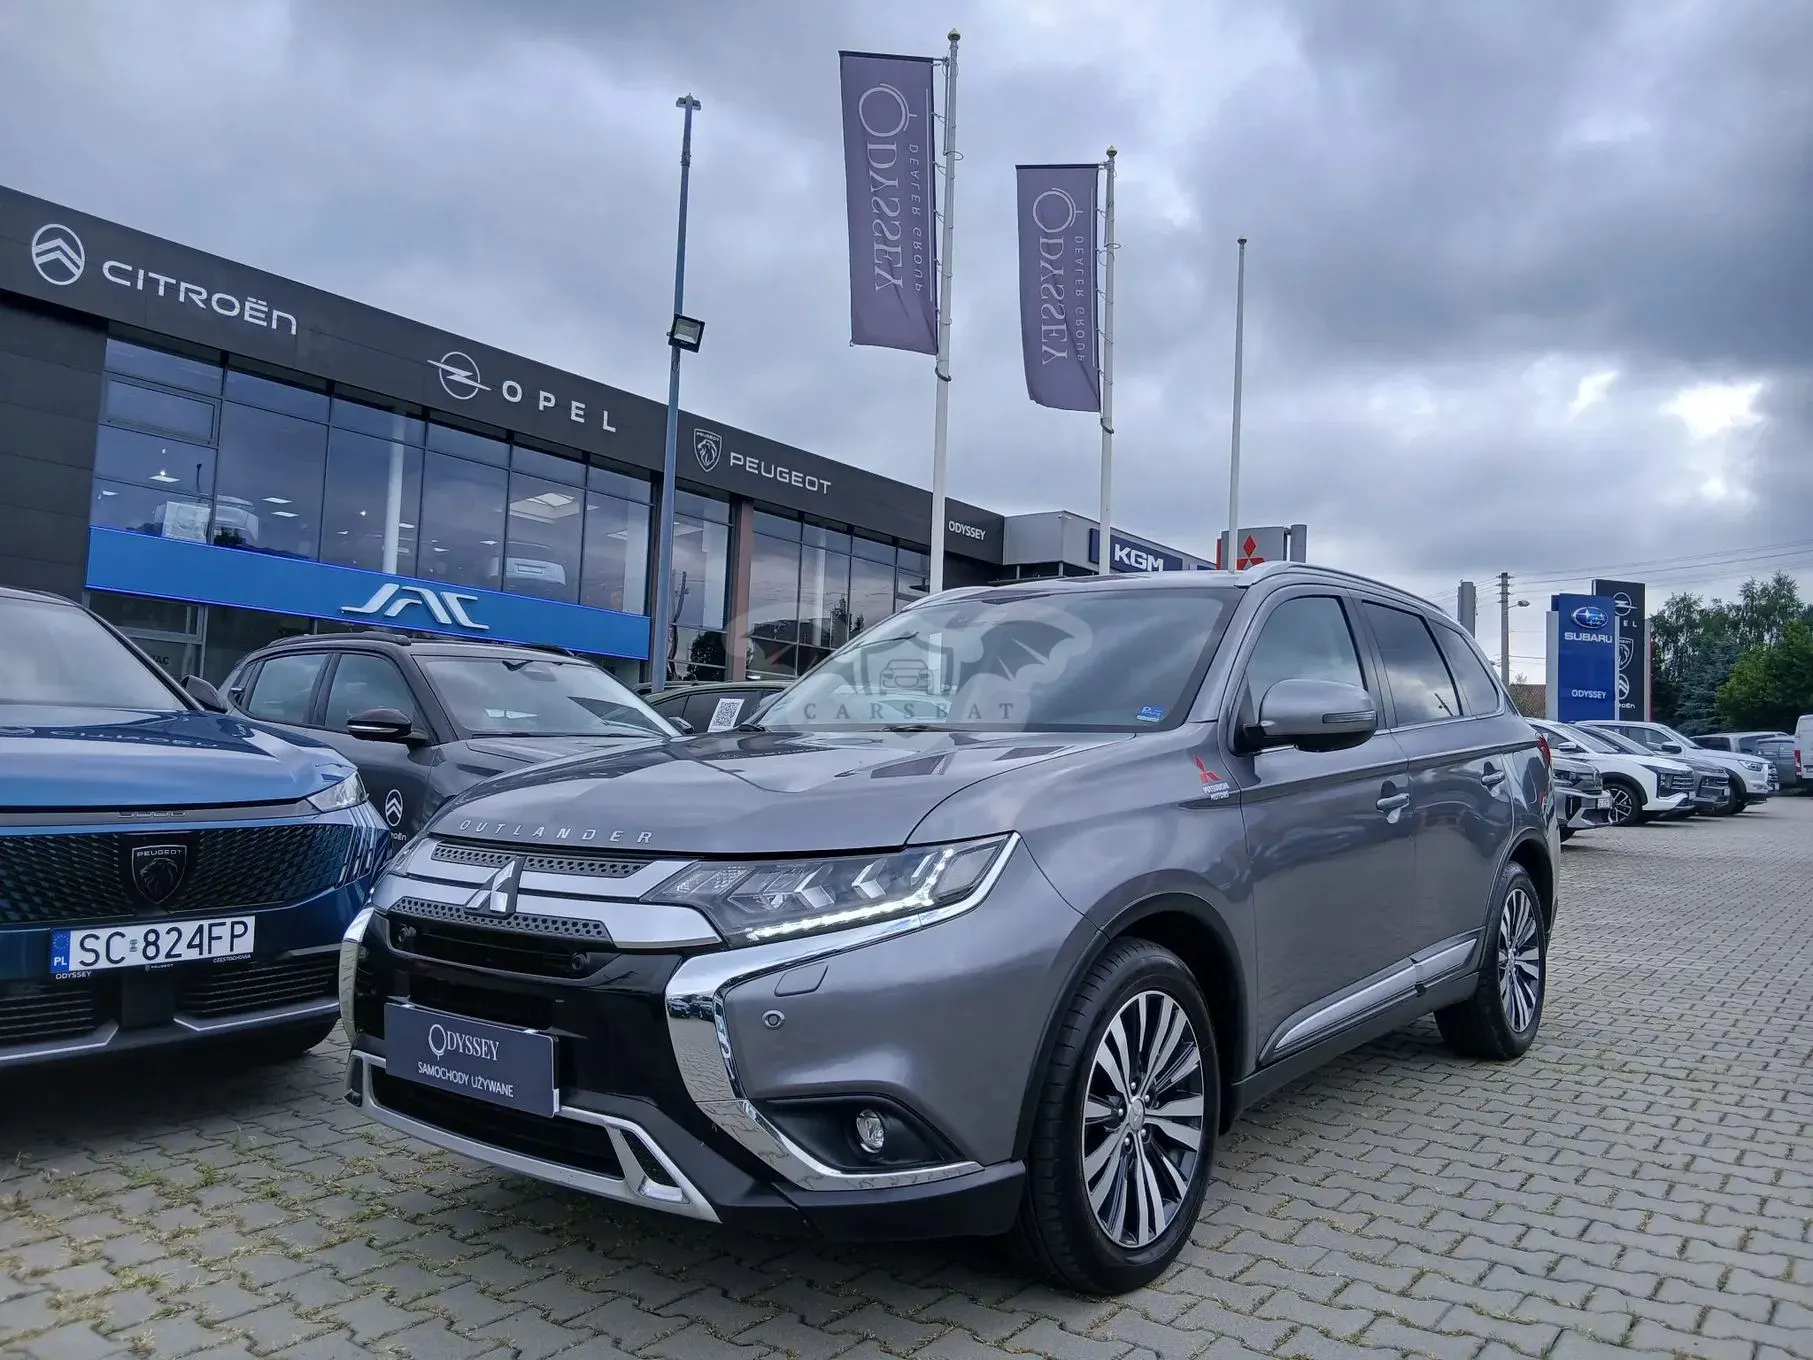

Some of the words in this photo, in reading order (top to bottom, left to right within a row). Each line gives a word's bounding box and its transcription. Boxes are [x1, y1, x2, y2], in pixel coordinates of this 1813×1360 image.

[502, 380, 617, 433] OPEL
[730, 451, 832, 494] PEUGEOT
[948, 520, 986, 540] ODYSSEY
[1114, 543, 1164, 571] KGM
[1563, 631, 1613, 643] SUBARU
[1571, 689, 1607, 699] ODYSSEY
[459, 819, 653, 843] OUTLANDER
[136, 849, 182, 857] PEUGEOT
[79, 931, 126, 967] SC
[142, 920, 249, 961] 824FP
[53, 956, 68, 967] PL
[55, 970, 92, 980] ODYSSEY
[428, 1024, 500, 1061] ODYSSEY
[418, 1061, 470, 1086] SAMOCHODY
[471, 1075, 514, 1098] UŻYWANE
